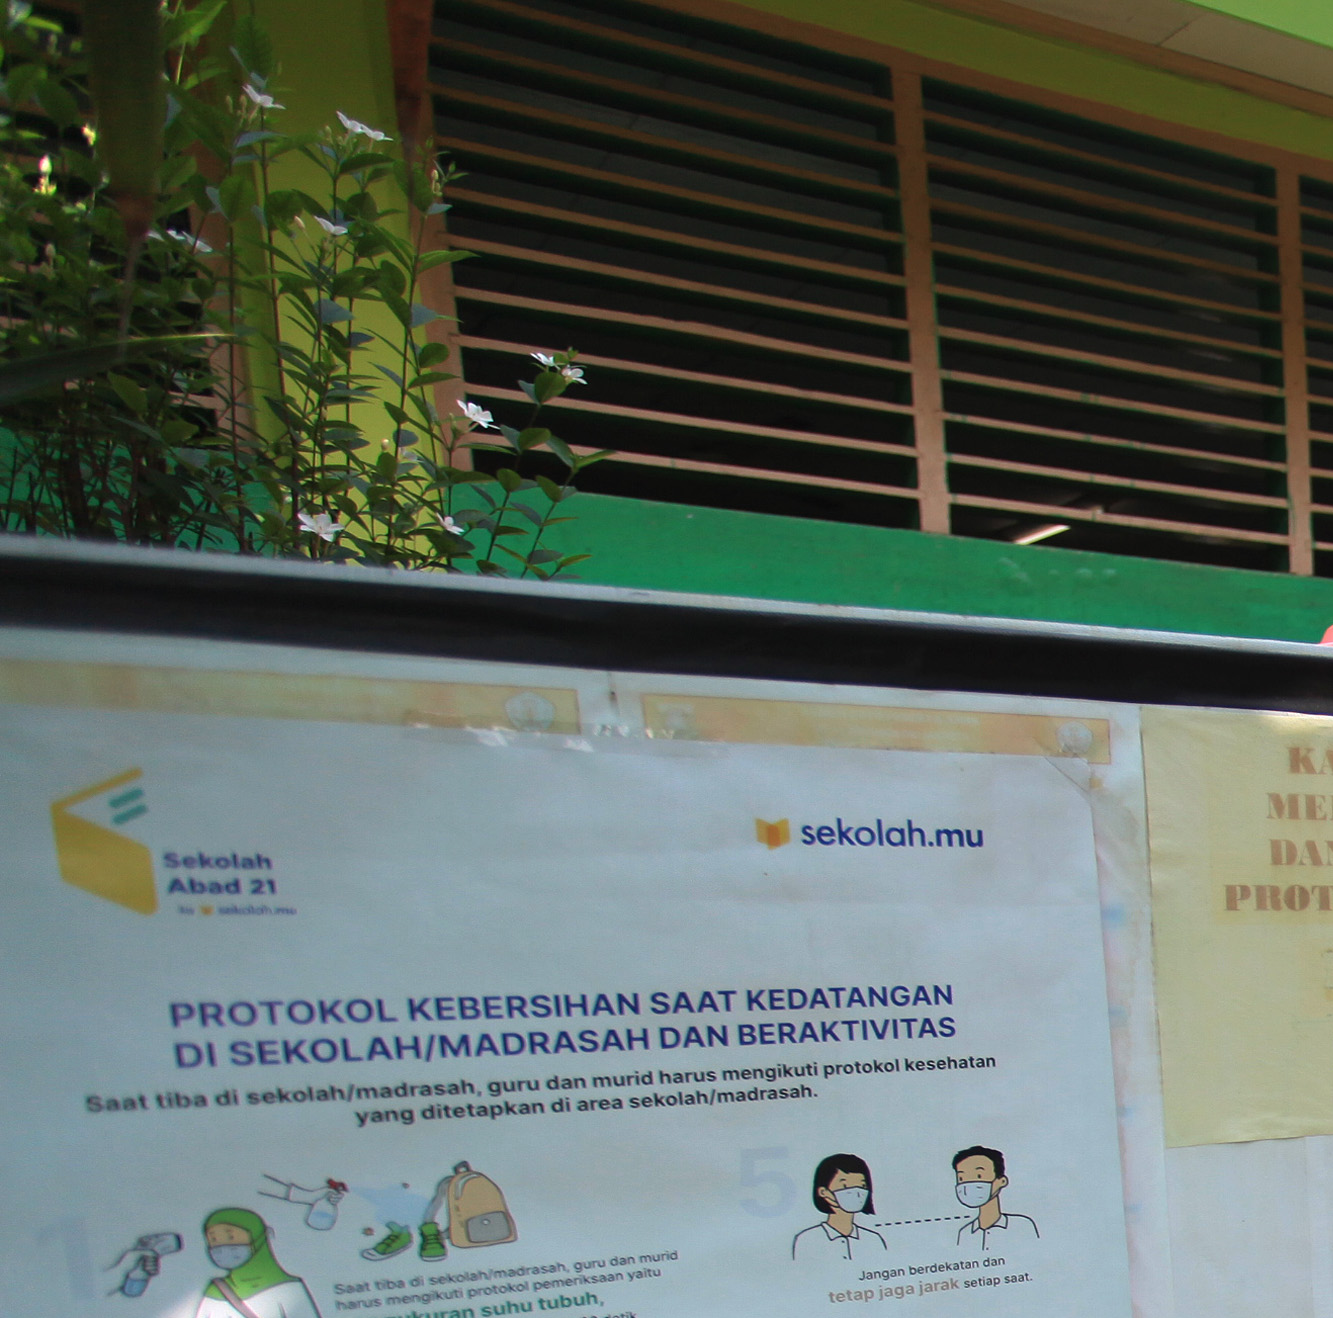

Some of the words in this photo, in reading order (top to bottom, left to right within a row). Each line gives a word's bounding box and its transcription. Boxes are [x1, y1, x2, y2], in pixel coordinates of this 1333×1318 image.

[801, 818, 984, 848] sekolah.mu
[163, 851, 274, 870] Sekolah
[168, 878, 242, 896] Abad
[250, 878, 277, 896] 21
[170, 999, 398, 1029] PROTOKOL
[407, 993, 640, 1022] KEBERSIHAN
[650, 990, 736, 1015] SAAT
[746, 984, 953, 1012] KEDATANGAN
[174, 1041, 217, 1069] DI
[230, 1027, 650, 1067] SEKOLAH/MADRASAH
[659, 1025, 730, 1050] DAN
[738, 1016, 956, 1046] BERAKTIVITAS
[86, 1093, 149, 1113] Saat
[156, 1090, 209, 1109] tiba
[215, 1088, 240, 1107] di
[247, 1078, 483, 1107] sekolah/madrasah,
[488, 1077, 540, 1098] guru
[546, 1073, 586, 1091] dan
[593, 1069, 654, 1089] murid
[659, 1067, 717, 1085] harus
[722, 1062, 819, 1084] mengikuti
[823, 1058, 900, 1079] protokol
[904, 1055, 996, 1073] kesehatan
[355, 1107, 415, 1128] yang
[421, 1099, 546, 1123] ditetapkan
[551, 1097, 572, 1114] di
[577, 1095, 624, 1112] area
[628, 1084, 819, 1109] sekolah/madrasah.
[333, 1279, 371, 1296] Saat
[374, 1276, 406, 1292] tiba
[410, 1275, 425, 1289] di
[429, 1261, 571, 1286] sekolah/madrasah,
[573, 1258, 606, 1274] guru
[610, 1254, 635, 1269] dan
[639, 1250, 678, 1265] murid
[828, 1286, 874, 1305] tetap
[878, 1282, 916, 1302] jaga
[918, 1277, 960, 1297] jarak
[963, 1274, 1001, 1290] setiap
[1003, 1271, 1033, 1285] saat.
[858, 1265, 906, 1283] Jangan
[908, 1258, 980, 1278] berdekatan
[982, 1255, 1006, 1269] dan
[335, 1296, 382, 1312] harus
[385, 1288, 464, 1308] mengikuti
[467, 1281, 529, 1301] protokol
[533, 1270, 624, 1295] pemeriksaan
[627, 1266, 661, 1283] yaitu
[481, 1300, 533, 1318] suhu
[537, 1291, 604, 1311] tubuh,
